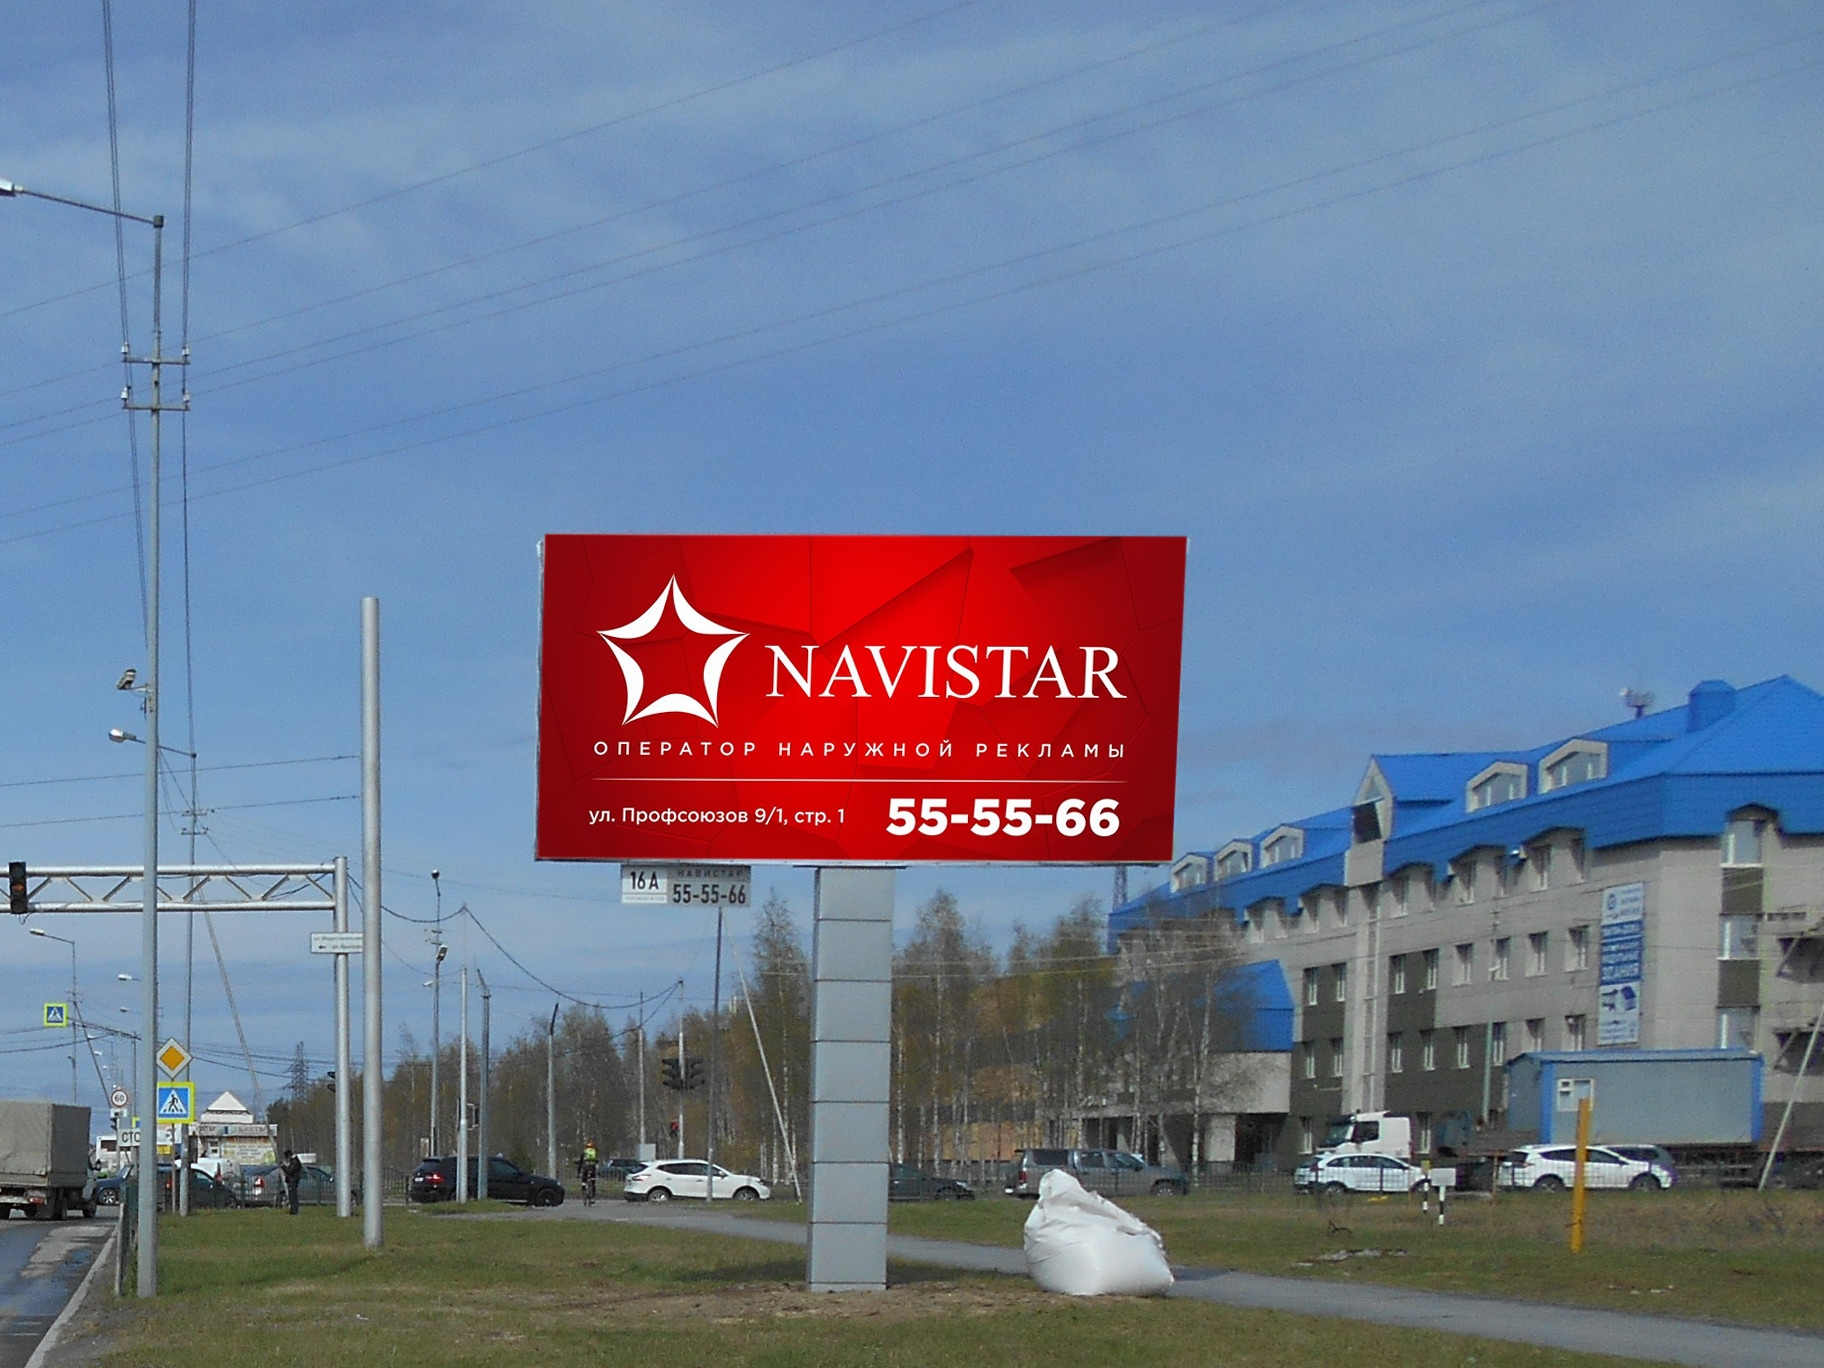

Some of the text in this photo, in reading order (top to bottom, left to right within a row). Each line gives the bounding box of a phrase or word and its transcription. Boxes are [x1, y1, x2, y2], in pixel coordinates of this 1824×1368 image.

[764, 644, 1128, 699] NAVISTAR
[592, 739, 1125, 758] ОПЕРАТОР НАРУЖНОЙ РЕКЛАМЫ
[588, 806, 845, 826] ул. Профсоюзов 9/1, стр. 1
[885, 797, 1120, 837] 55-55-66
[630, 871, 646, 890] 16
[677, 868, 742, 878] НАВИСТАР
[673, 884, 746, 904] 55-55-66
[114, 1094, 125, 1103] 60
